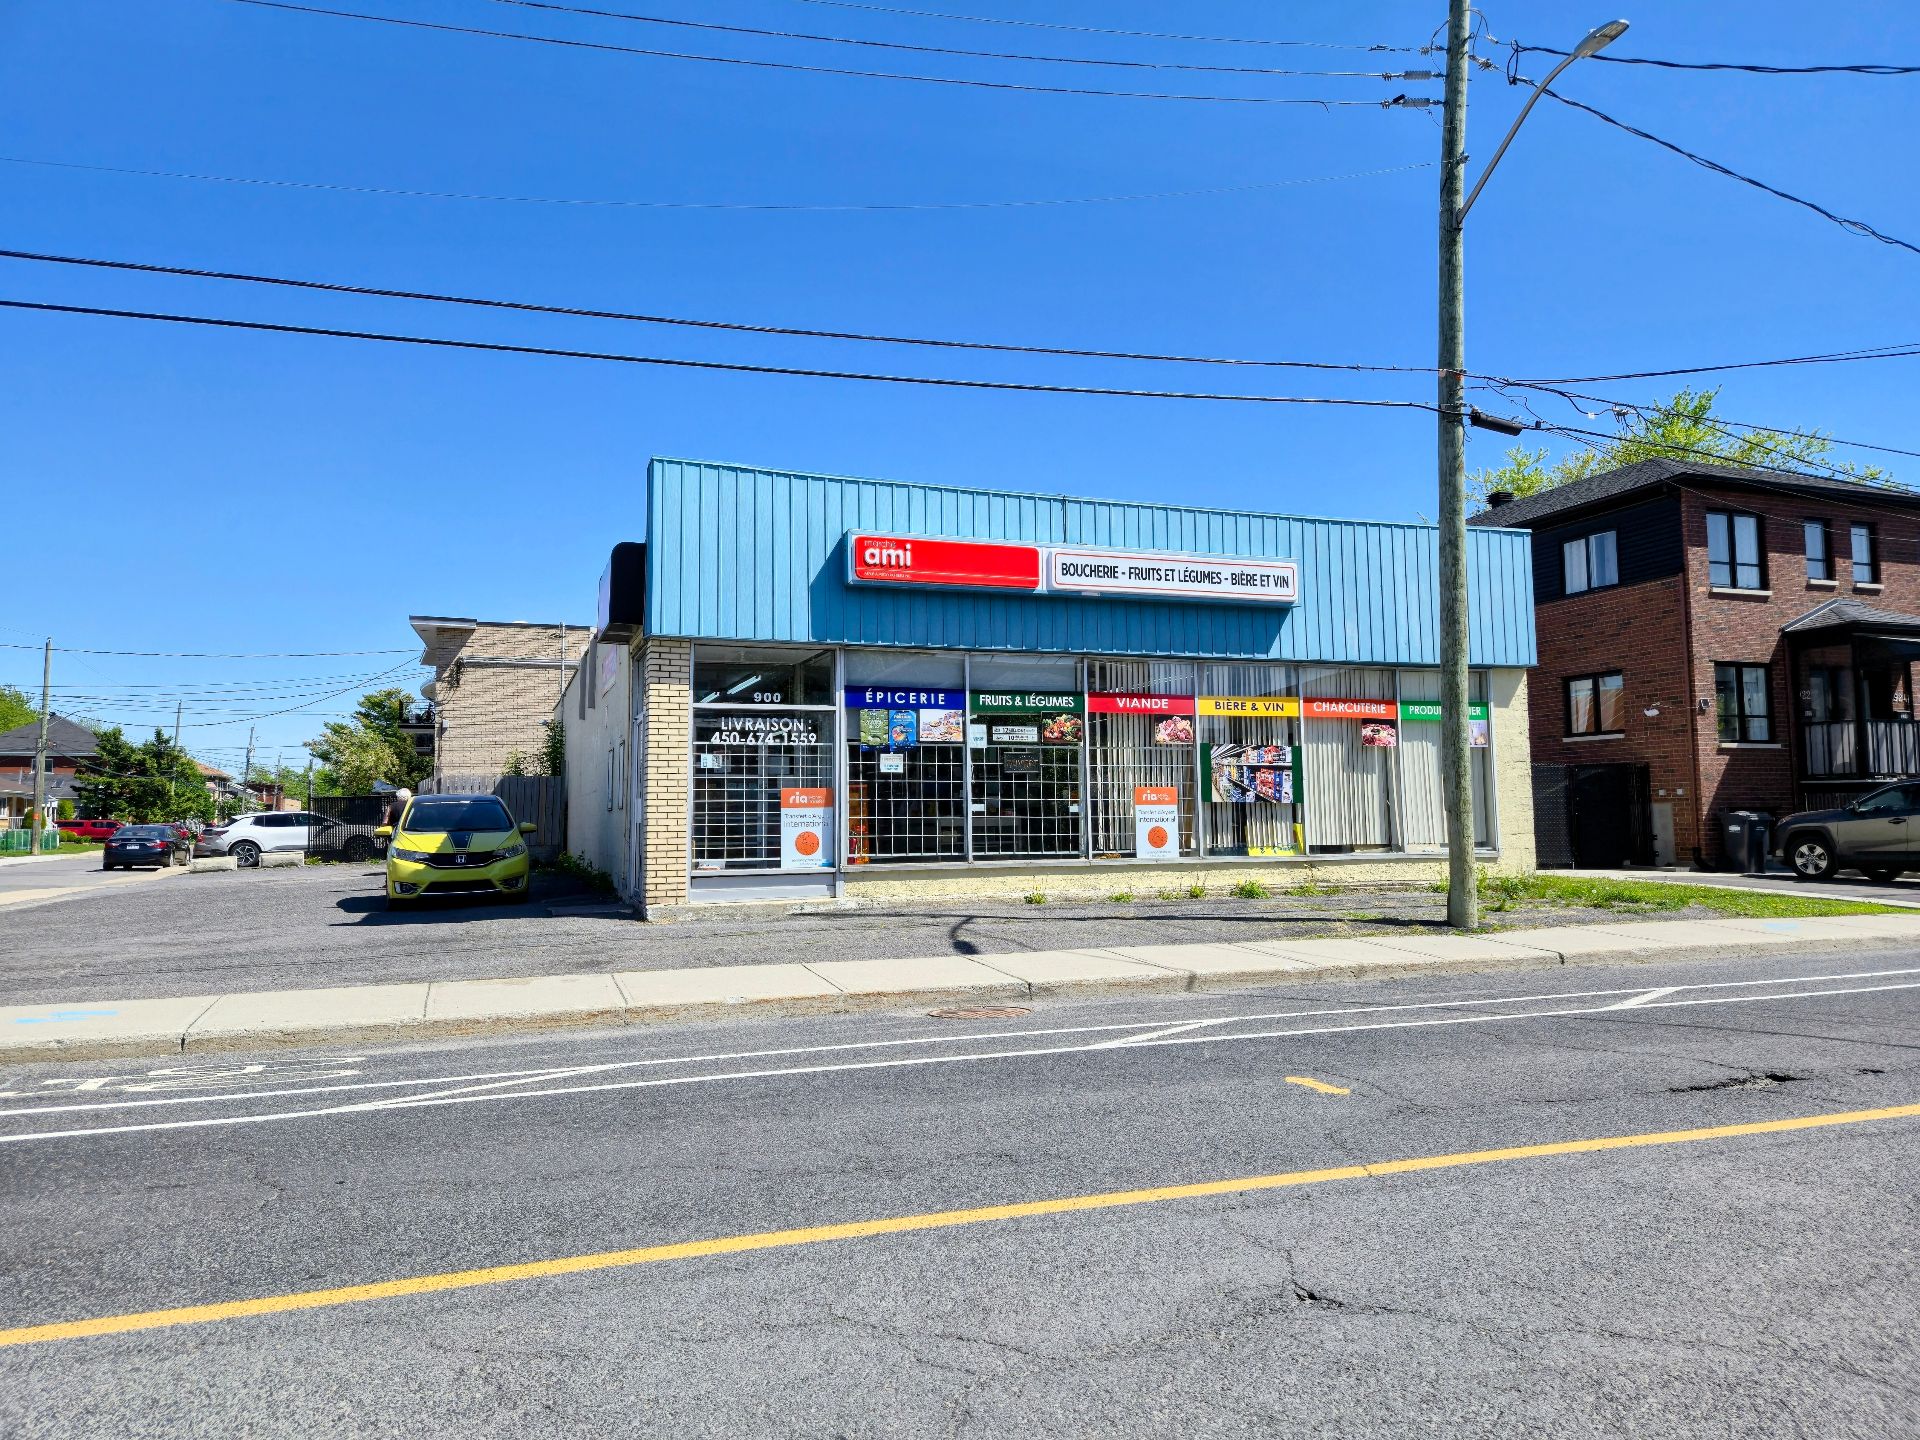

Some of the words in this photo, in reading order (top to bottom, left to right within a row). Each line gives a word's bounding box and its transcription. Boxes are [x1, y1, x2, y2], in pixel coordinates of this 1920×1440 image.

[864, 544, 911, 567] ami
[1061, 562, 1119, 579] BOUCHERIE
[1128, 566, 1162, 582] FRUITS
[1164, 568, 1176, 582] ET
[1178, 567, 1222, 584] LÉGUMES
[1231, 570, 1257, 587] BIÈRE
[1260, 574, 1271, 587] ET
[1273, 575, 1289, 588] VIN
[754, 692, 781, 702] 900
[866, 688, 945, 704] ÉPICERIE
[980, 695, 1012, 706] FRUITS
[1015, 696, 1022, 706] &
[1026, 693, 1074, 707] LÉGUMES
[1116, 698, 1168, 709] VIANDE
[1215, 699, 1247, 711] BIÈRE
[1251, 703, 1258, 711] &
[1264, 703, 1284, 711] VIN
[1313, 702, 1386, 714] CHARCUTERIE
[1409, 706, 1441, 714] PRODUI
[721, 717, 804, 731] LIVRAISON
[711, 732, 817, 745] 450-674-1559
[789, 791, 808, 804] ria
[1143, 790, 1157, 800] ria
